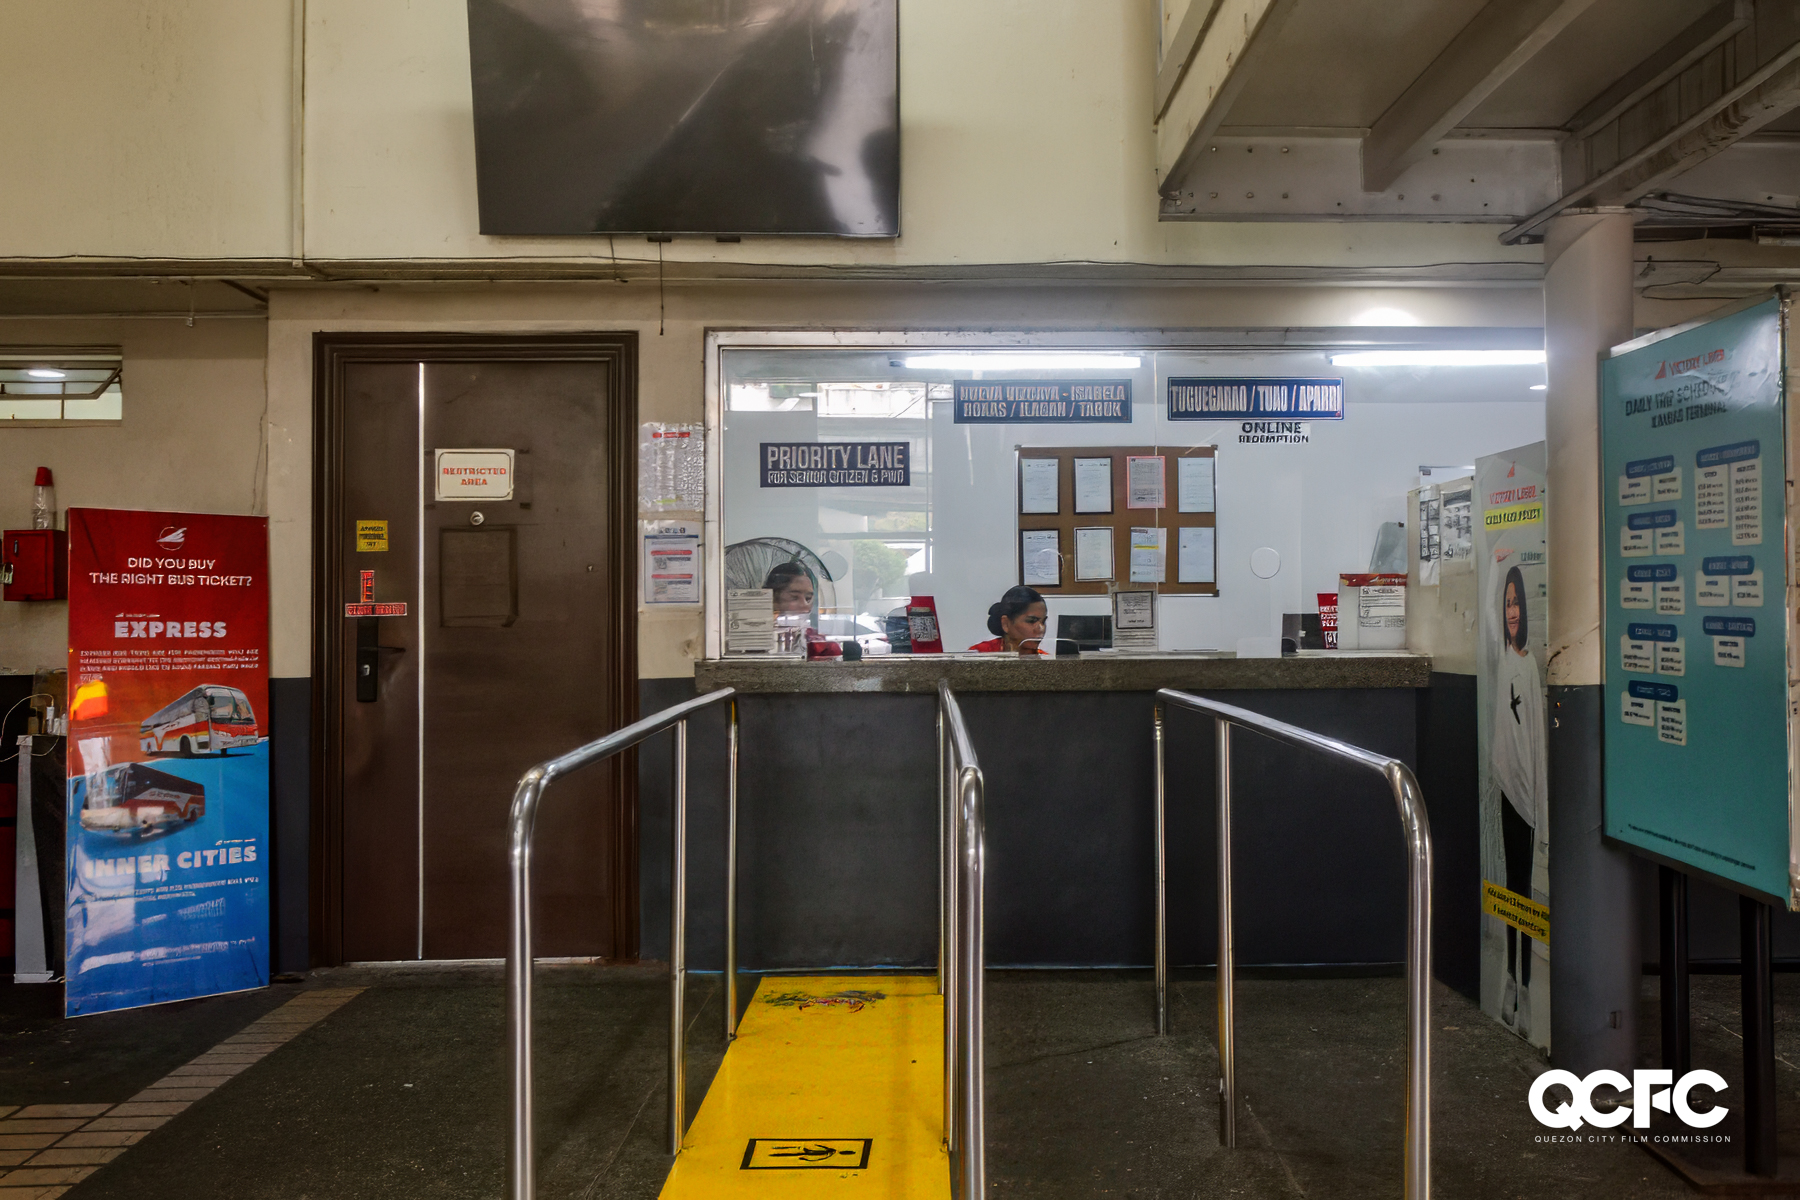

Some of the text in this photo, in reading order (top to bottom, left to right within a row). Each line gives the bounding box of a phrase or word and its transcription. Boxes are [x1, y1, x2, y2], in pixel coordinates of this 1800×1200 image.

[1171, 385, 1247, 412] TUGUEGARAO
[1257, 385, 1288, 412] TUAO
[1241, 422, 1302, 434] ONLINE
[1238, 434, 1309, 444] REDEMPTION
[767, 445, 904, 469] PRIORITY LANE
[460, 478, 488, 486] AREA
[768, 470, 787, 484] FOR
[788, 470, 827, 484] SENIOR
[829, 469, 868, 484] CITIZEN
[881, 469, 904, 483] PWD
[128, 557, 216, 570] DID YOU BUY
[89, 572, 252, 587] THE RIGHT BUS TICKET?
[114, 620, 227, 639] EXPRESS
[84, 845, 257, 879] INNER CITIES
